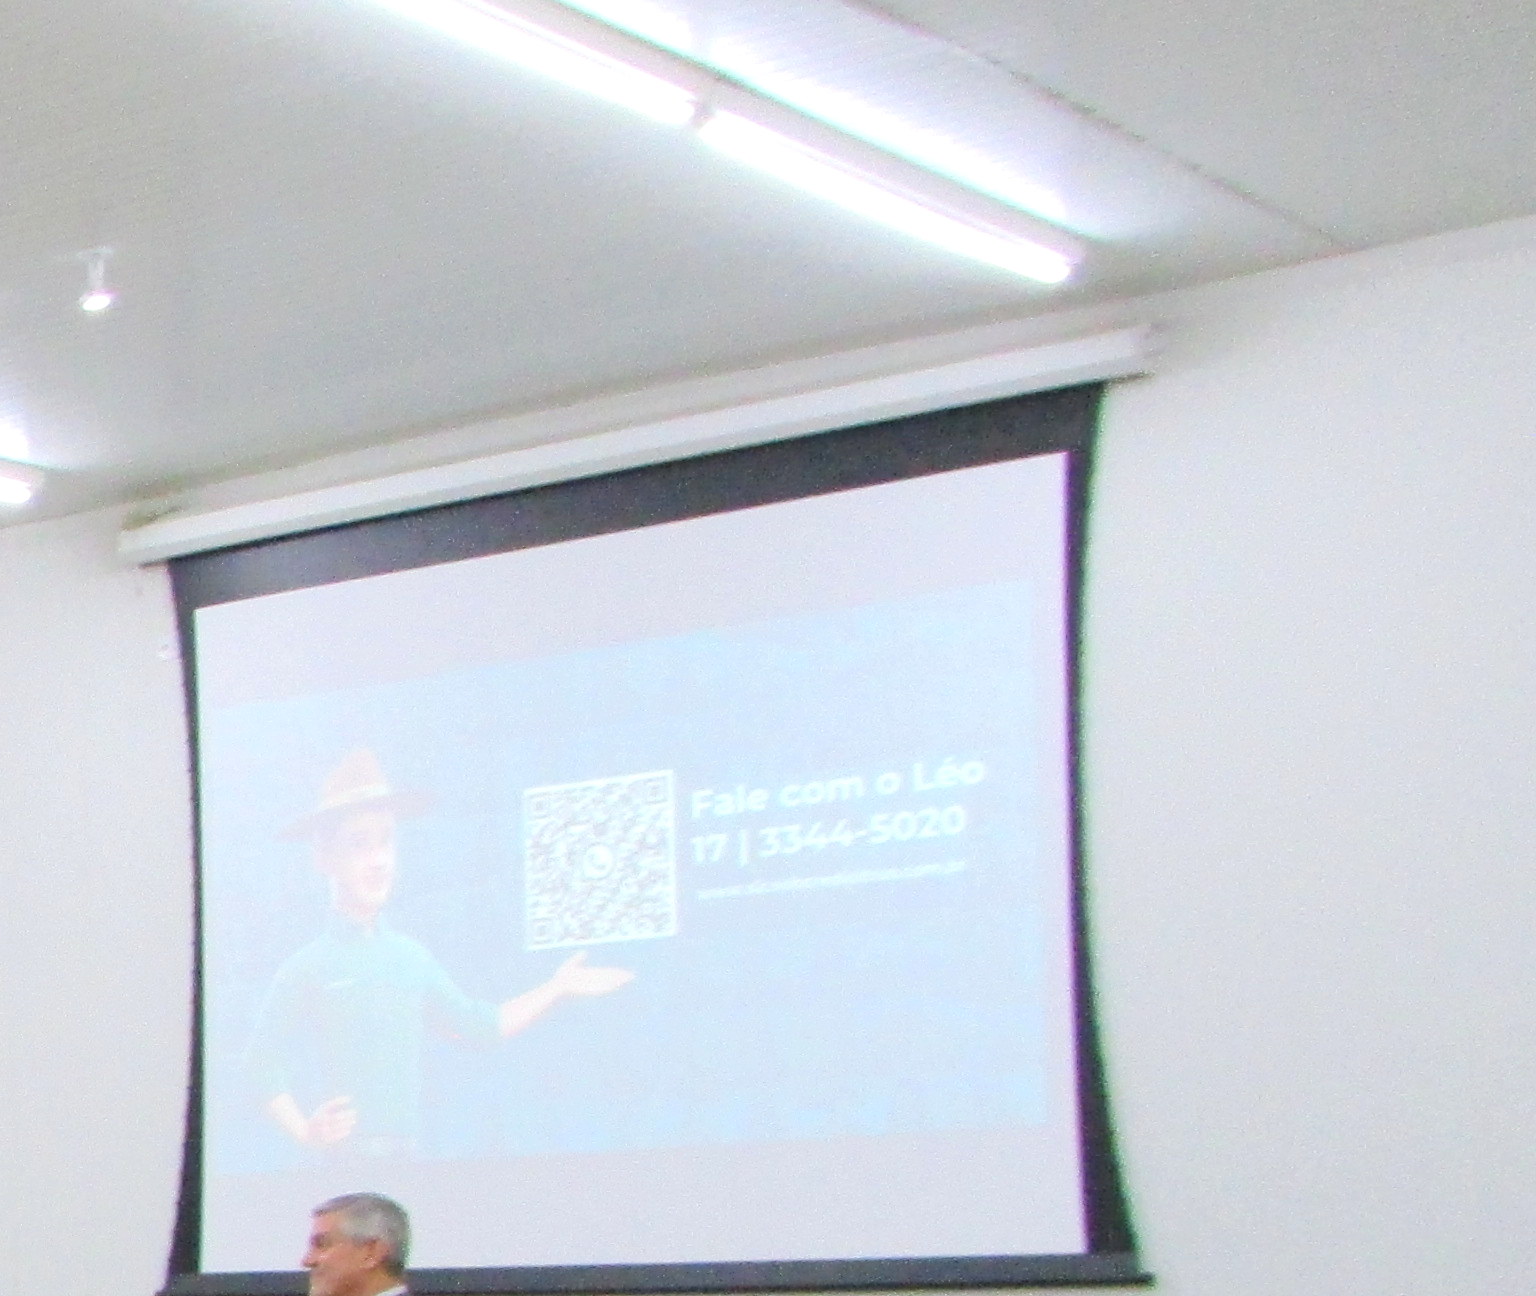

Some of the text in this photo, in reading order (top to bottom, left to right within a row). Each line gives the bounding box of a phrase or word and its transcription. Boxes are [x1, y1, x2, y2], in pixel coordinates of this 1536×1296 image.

[692, 757, 987, 818] Fale com o Léo
[691, 833, 729, 863] 17
[760, 804, 969, 856] 3344-5020
